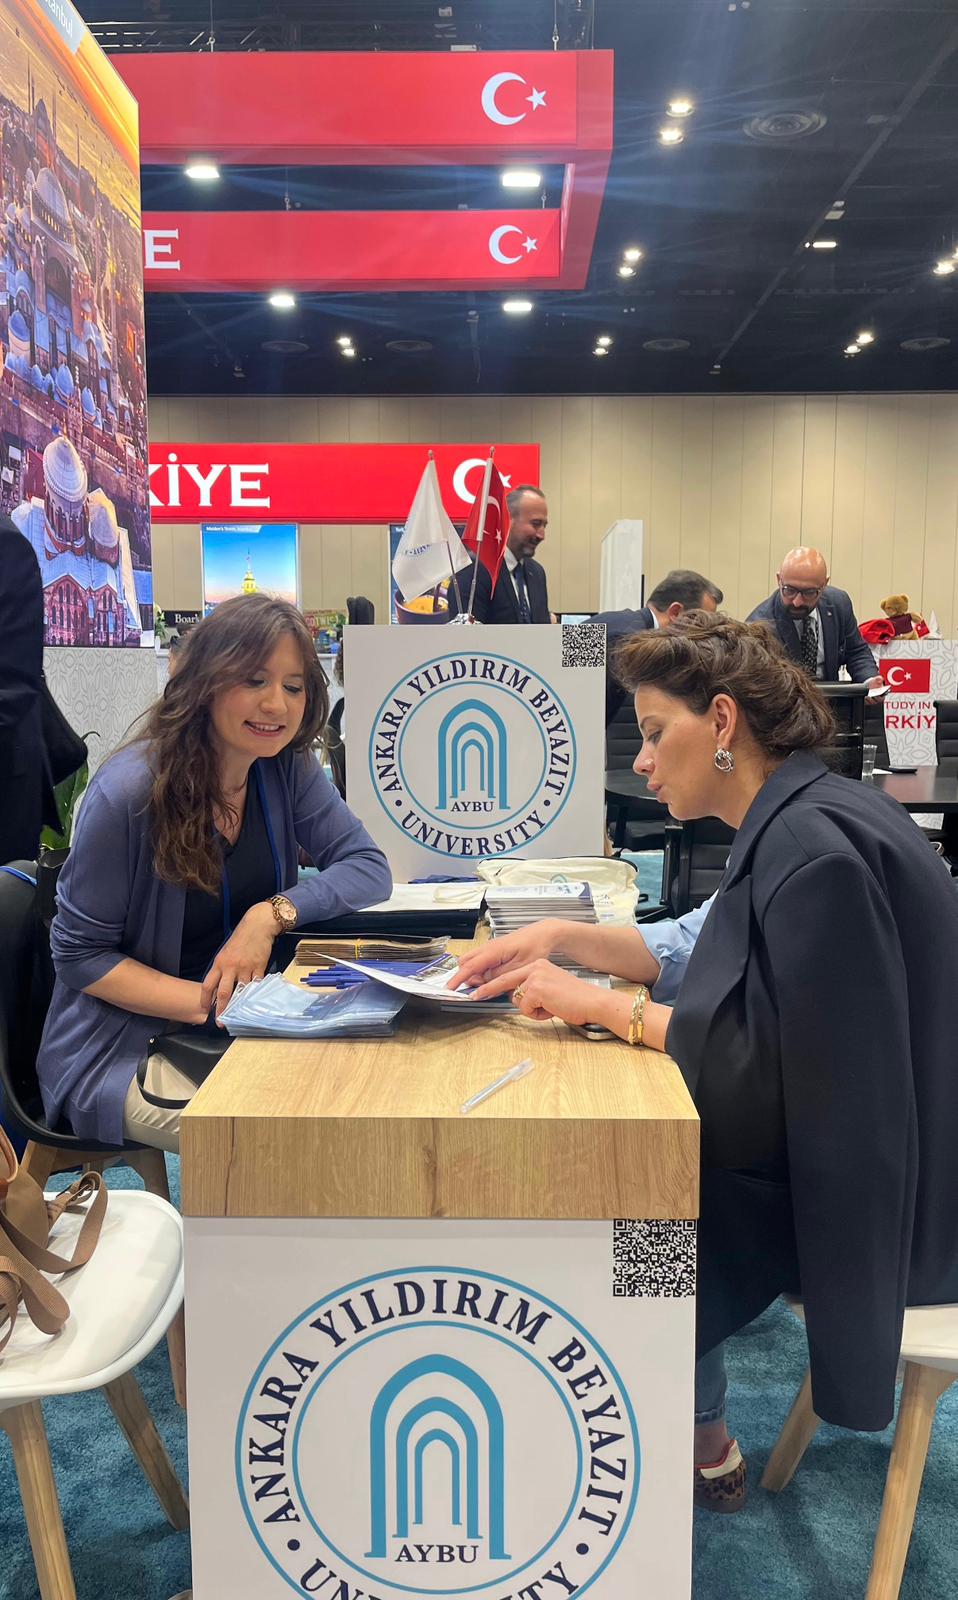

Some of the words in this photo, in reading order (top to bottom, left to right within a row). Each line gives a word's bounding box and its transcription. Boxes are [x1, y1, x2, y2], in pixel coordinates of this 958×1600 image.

[45, 0, 73, 38] anbul
[918, 701, 931, 710] IN
[375, 698, 412, 793] ANKARA
[407, 658, 532, 697] YILDIRIM
[529, 689, 570, 796] BEYAZIT
[451, 801, 495, 812] AYBU
[401, 810, 546, 856] UNIVERSITY
[249, 1350, 320, 1526] ANKARA
[309, 1279, 552, 1349] YILDIRIM
[548, 1337, 627, 1537] BEYAZIT
[394, 1544, 479, 1563] AYBU
